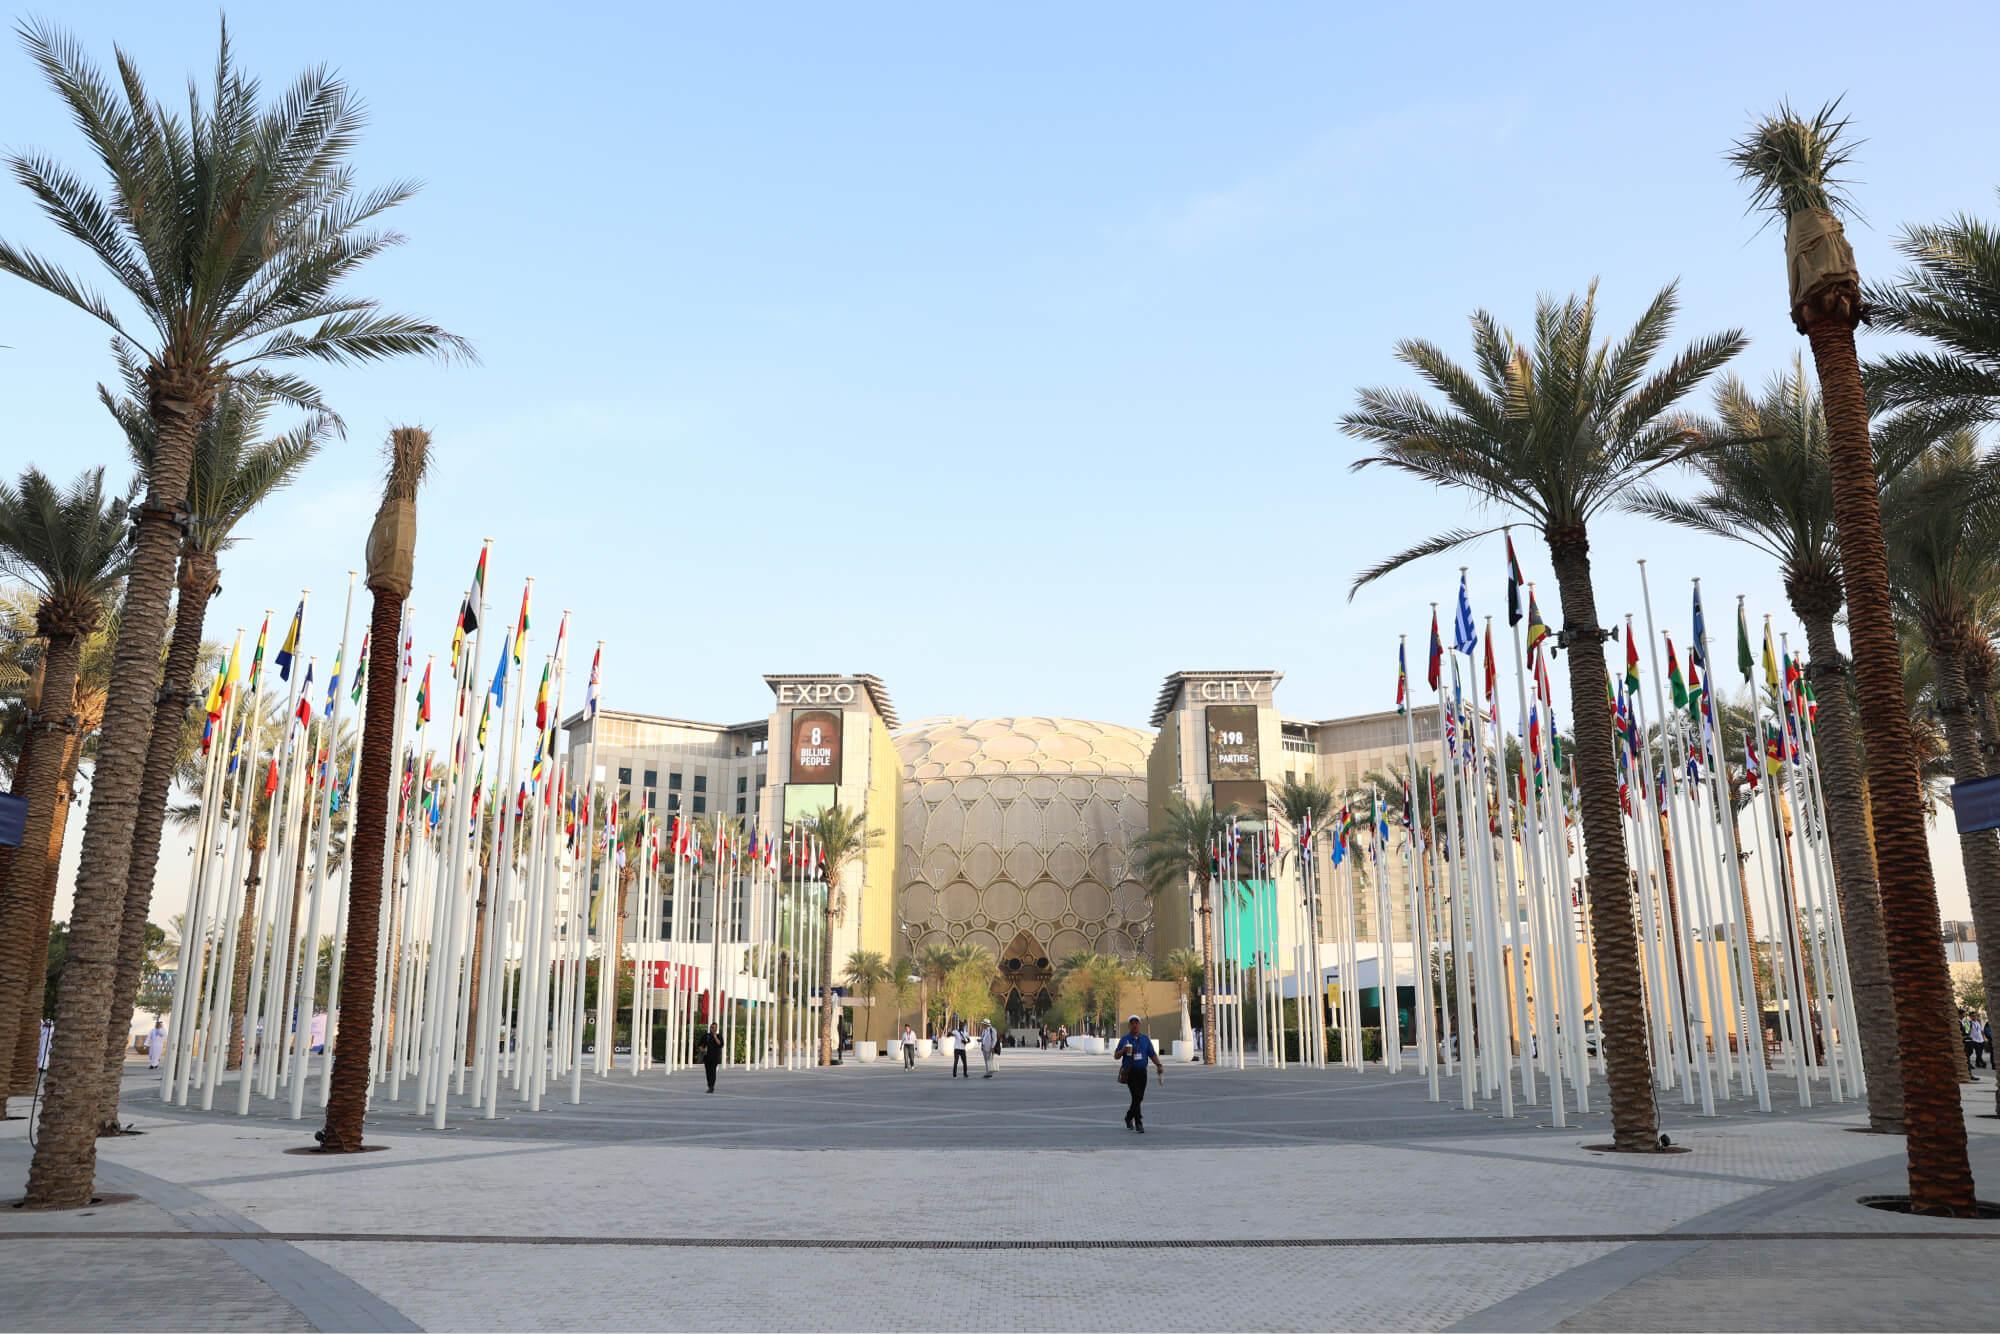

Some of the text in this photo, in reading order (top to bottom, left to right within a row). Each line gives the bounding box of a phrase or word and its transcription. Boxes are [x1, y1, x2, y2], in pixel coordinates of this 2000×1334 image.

[779, 683, 854, 703] EXPO
[1201, 680, 1260, 700] CITY
[811, 727, 821, 745] 8
[1222, 732, 1243, 744] 198
[800, 748, 831, 757] BILLION
[1219, 754, 1249, 763] PARTIES
[800, 757, 831, 766] PEOPLE
